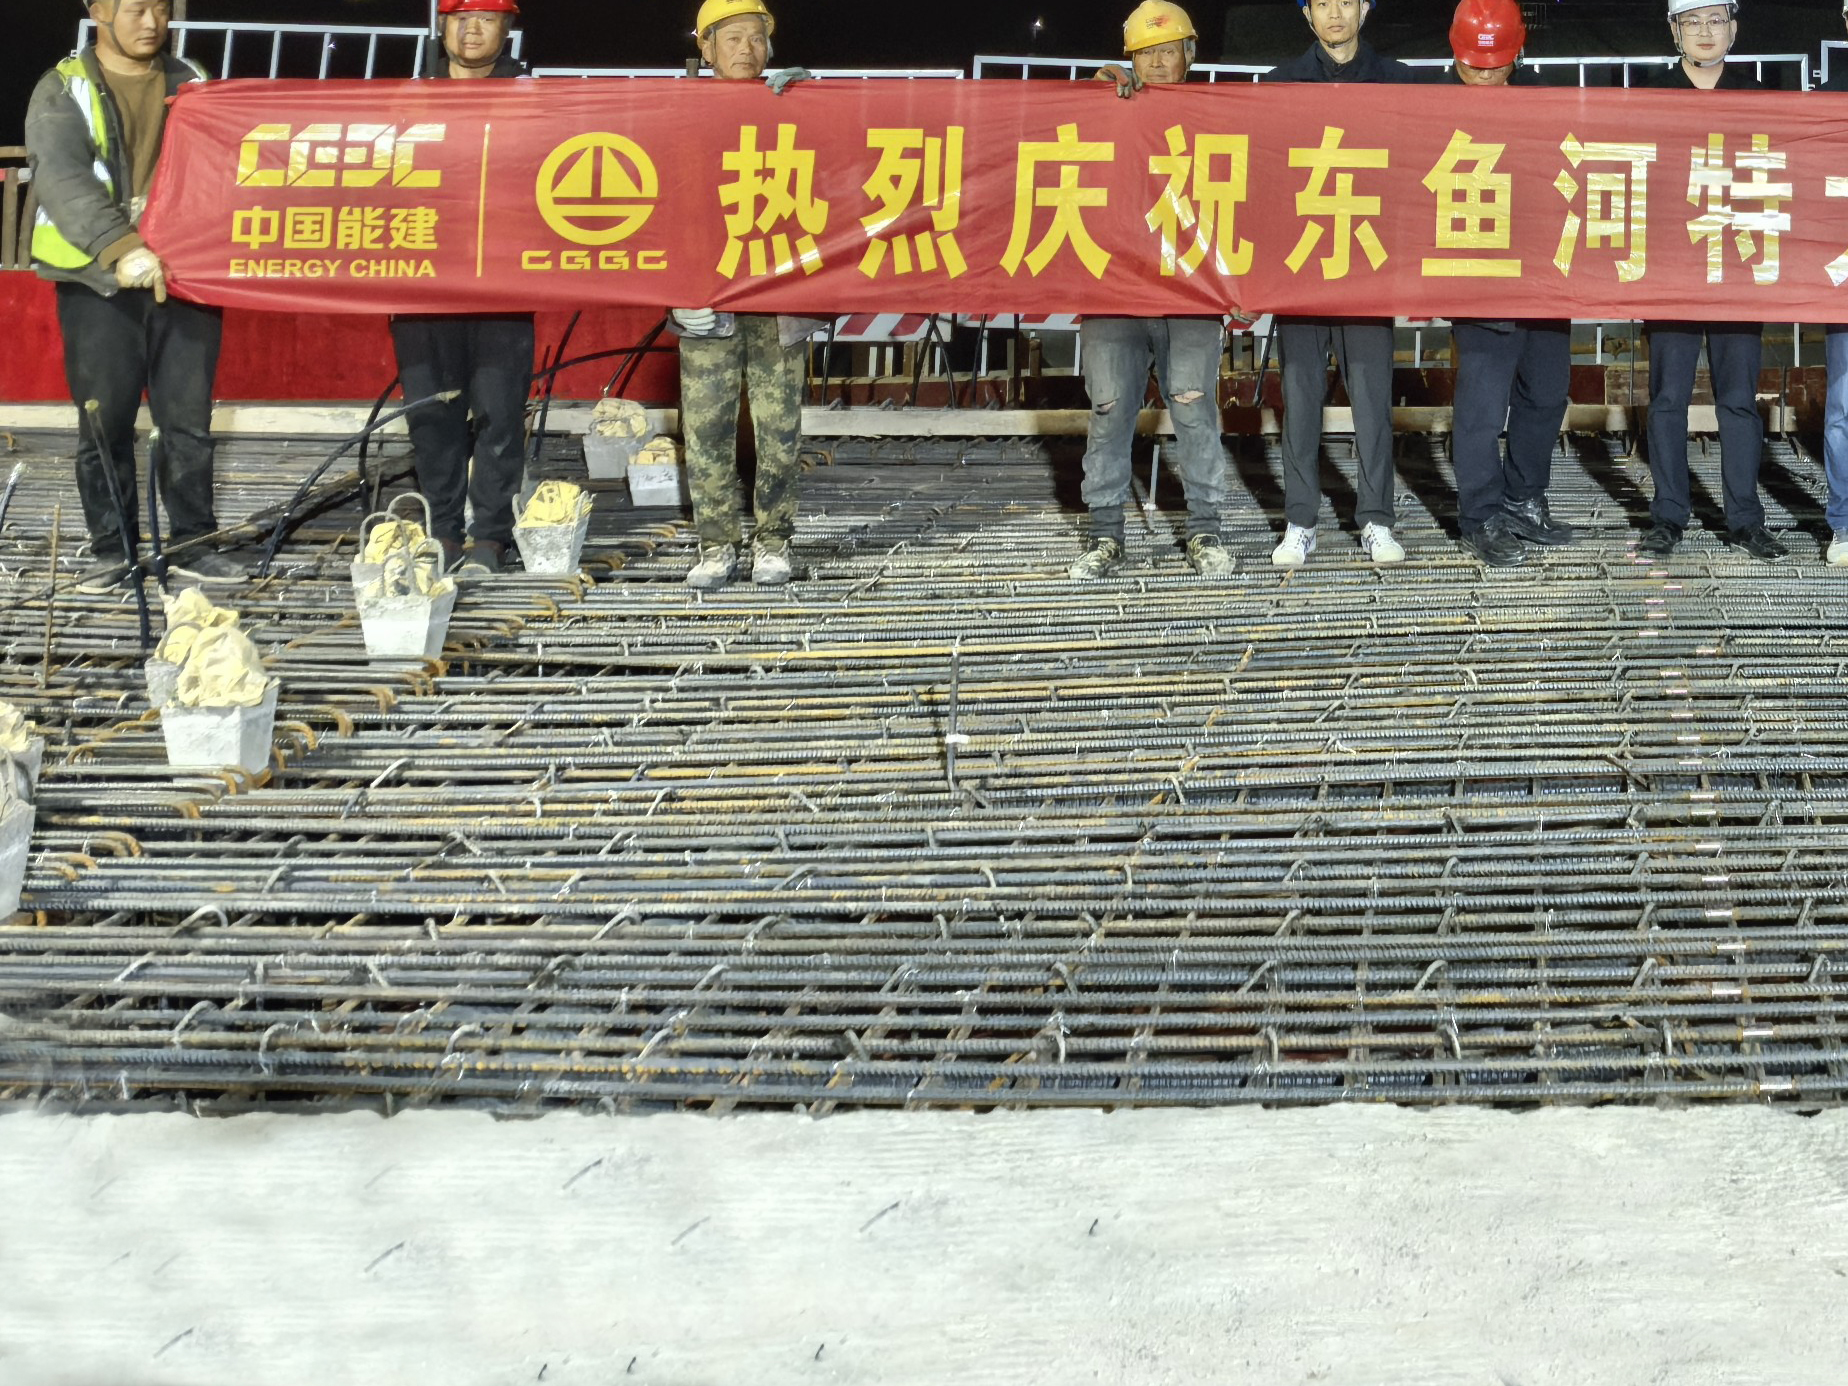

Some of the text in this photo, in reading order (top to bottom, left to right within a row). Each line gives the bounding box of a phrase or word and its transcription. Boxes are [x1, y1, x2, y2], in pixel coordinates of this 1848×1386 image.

[231, 205, 439, 251] 中国能建
[228, 258, 437, 279] ENERGY CHINA
[521, 249, 668, 271] CGGC
